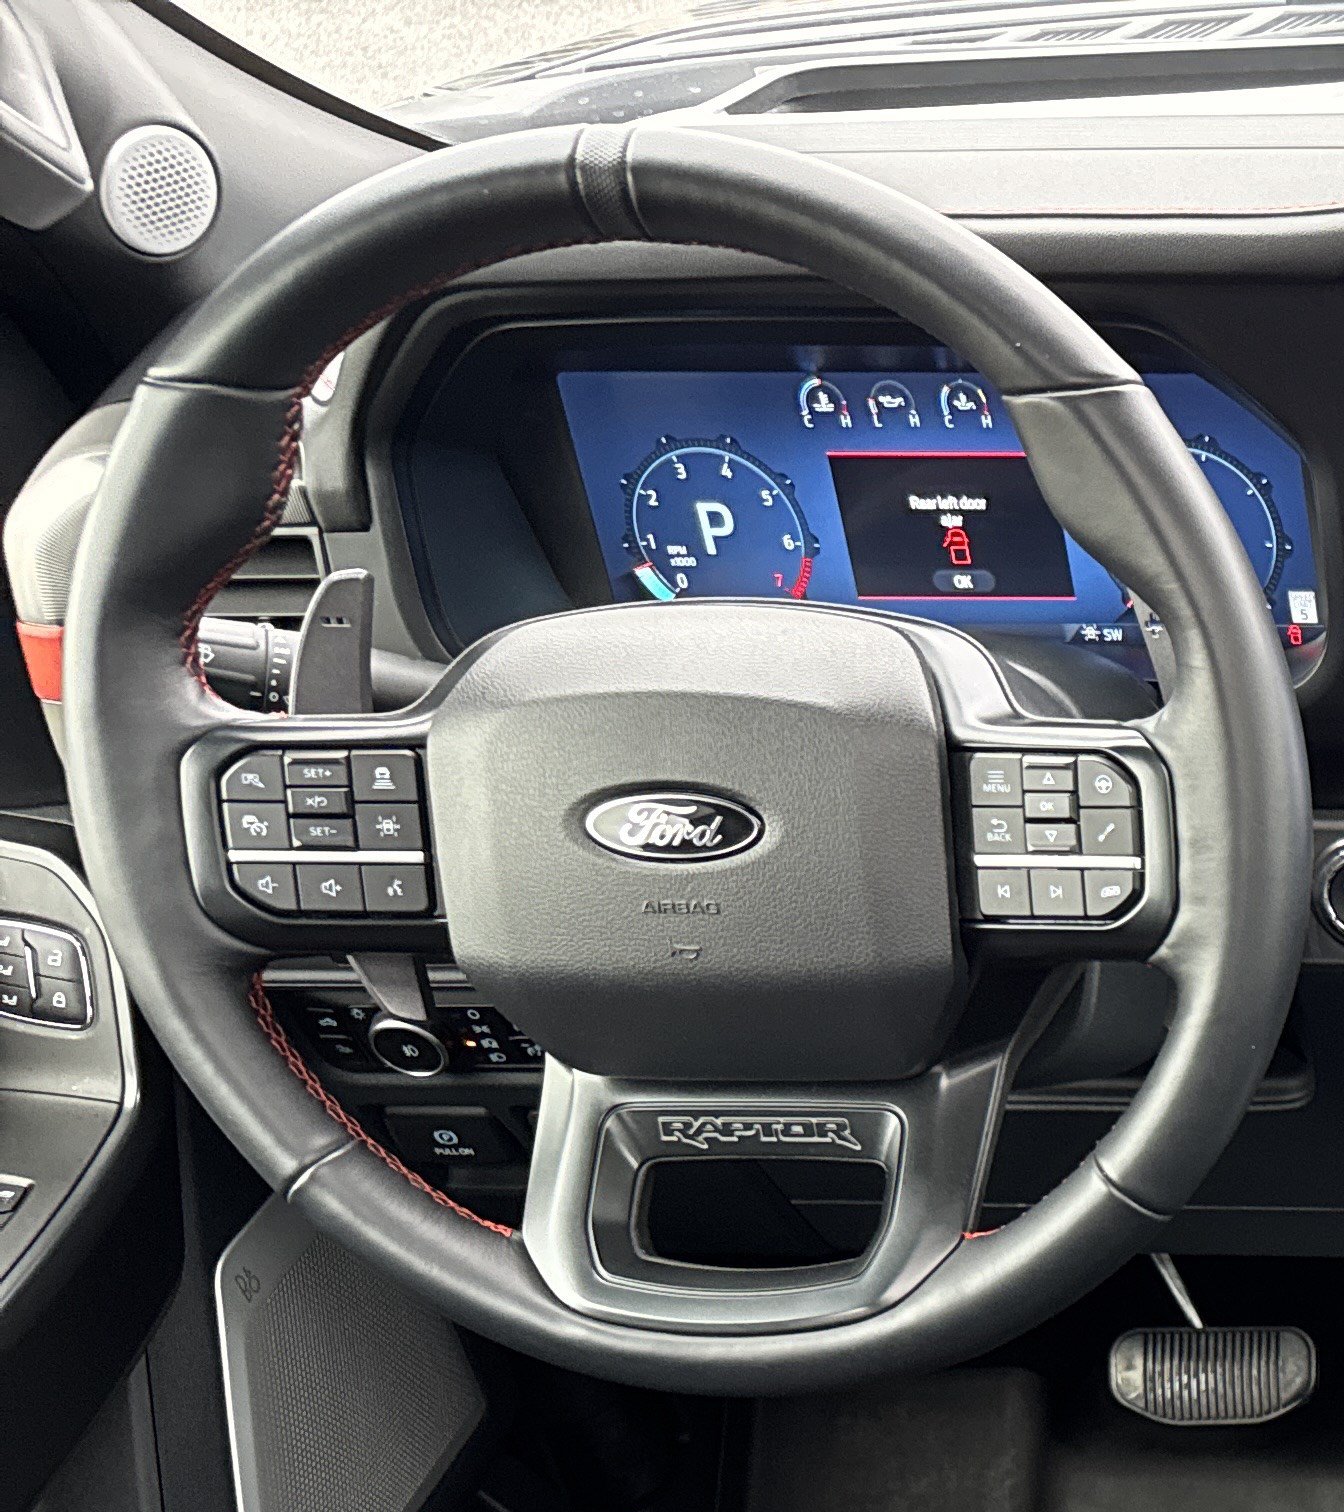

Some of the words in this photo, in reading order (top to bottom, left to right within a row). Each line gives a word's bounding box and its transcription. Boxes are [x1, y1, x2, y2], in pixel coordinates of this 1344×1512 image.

[804, 414, 814, 428] C
[840, 414, 853, 428] H
[873, 414, 883, 428] L
[909, 414, 921, 428] H
[944, 415, 954, 428] C
[981, 414, 992, 428] H
[674, 463, 687, 480] 3
[721, 463, 733, 480] 4
[647, 489, 659, 507] 2
[760, 489, 773, 507] 5
[909, 495, 937, 510] Rear
[936, 495, 960, 510] left
[960, 495, 987, 511] door
[695, 501, 735, 556] P
[647, 534, 656, 550] 1
[782, 534, 795, 551] 6
[676, 573, 689, 589] 0
[773, 573, 783, 587] 7
[953, 574, 974, 589] OK
[1301, 608, 1308, 621] 5
[1104, 628, 1123, 642] SW
[983, 784, 1012, 793] MENU
[1040, 802, 1055, 812] OK
[620, 802, 724, 848] Ford
[987, 832, 1012, 842] BACK
[641, 899, 722, 915] AIRBAG
[658, 1116, 862, 1151] RAPTOR
[434, 1147, 459, 1156] PULL
[459, 1147, 476, 1156] ON
